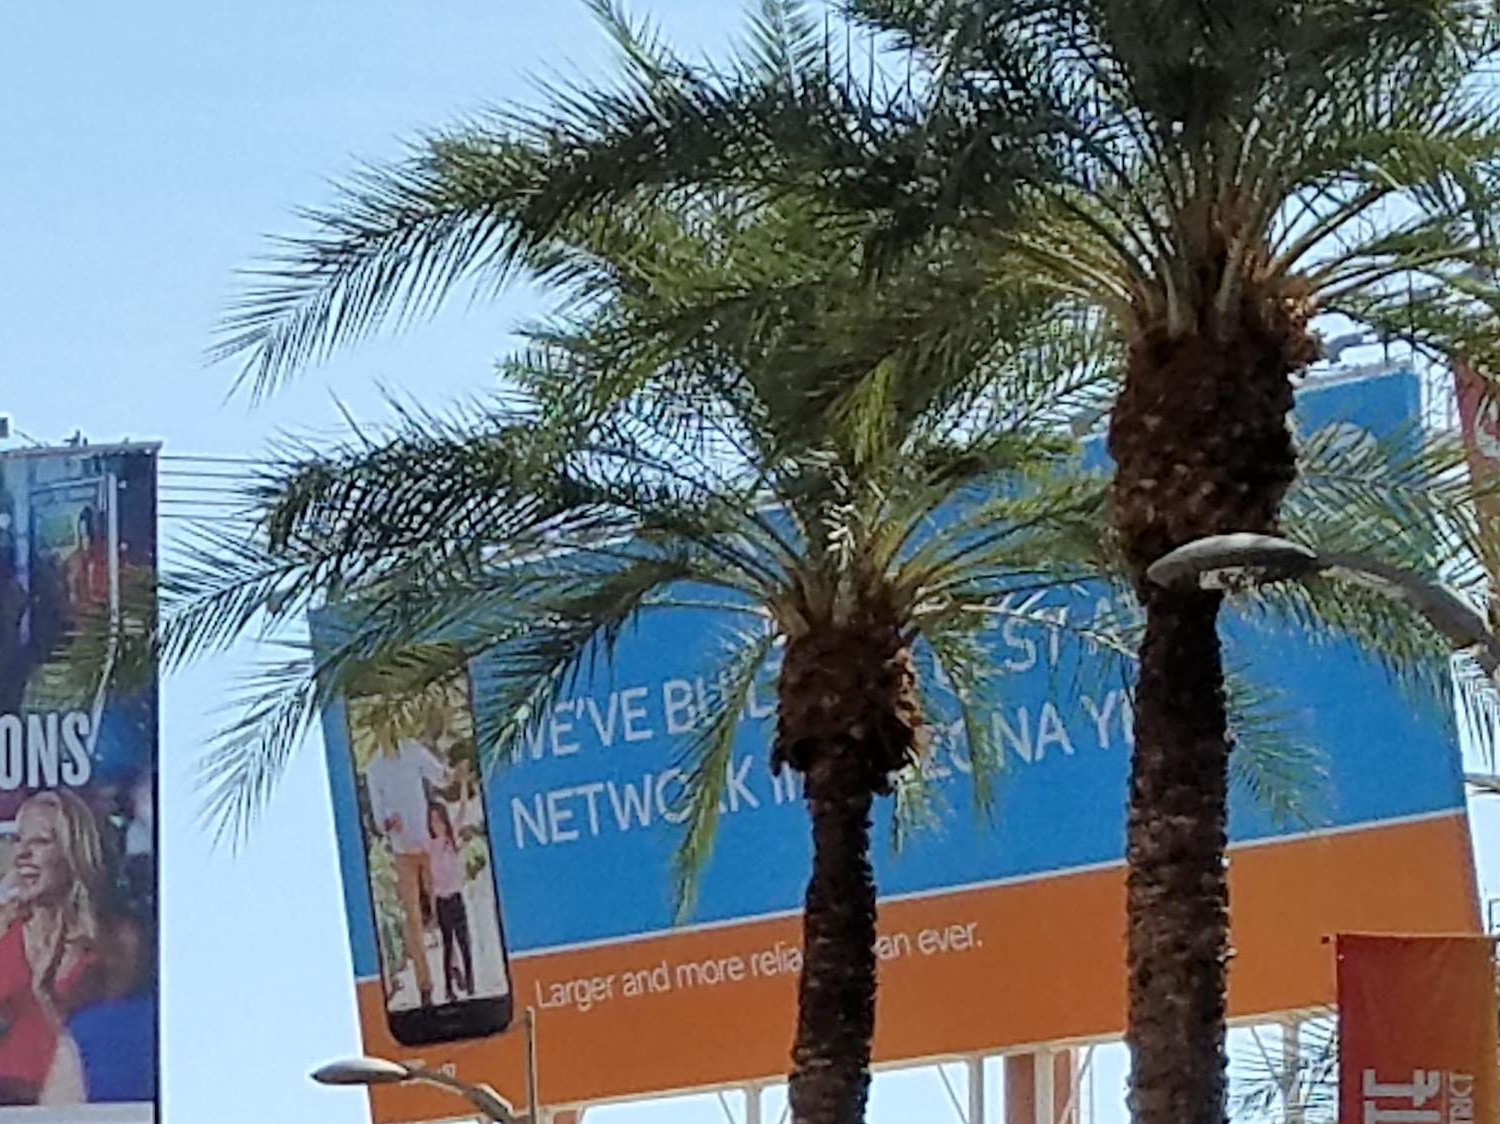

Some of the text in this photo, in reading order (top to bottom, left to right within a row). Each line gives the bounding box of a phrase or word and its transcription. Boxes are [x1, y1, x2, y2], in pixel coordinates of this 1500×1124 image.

[510, 687, 654, 764] WE'VE
[511, 755, 760, 849] NETWOK
[533, 919, 984, 1012] Larger and more relia an ever.
